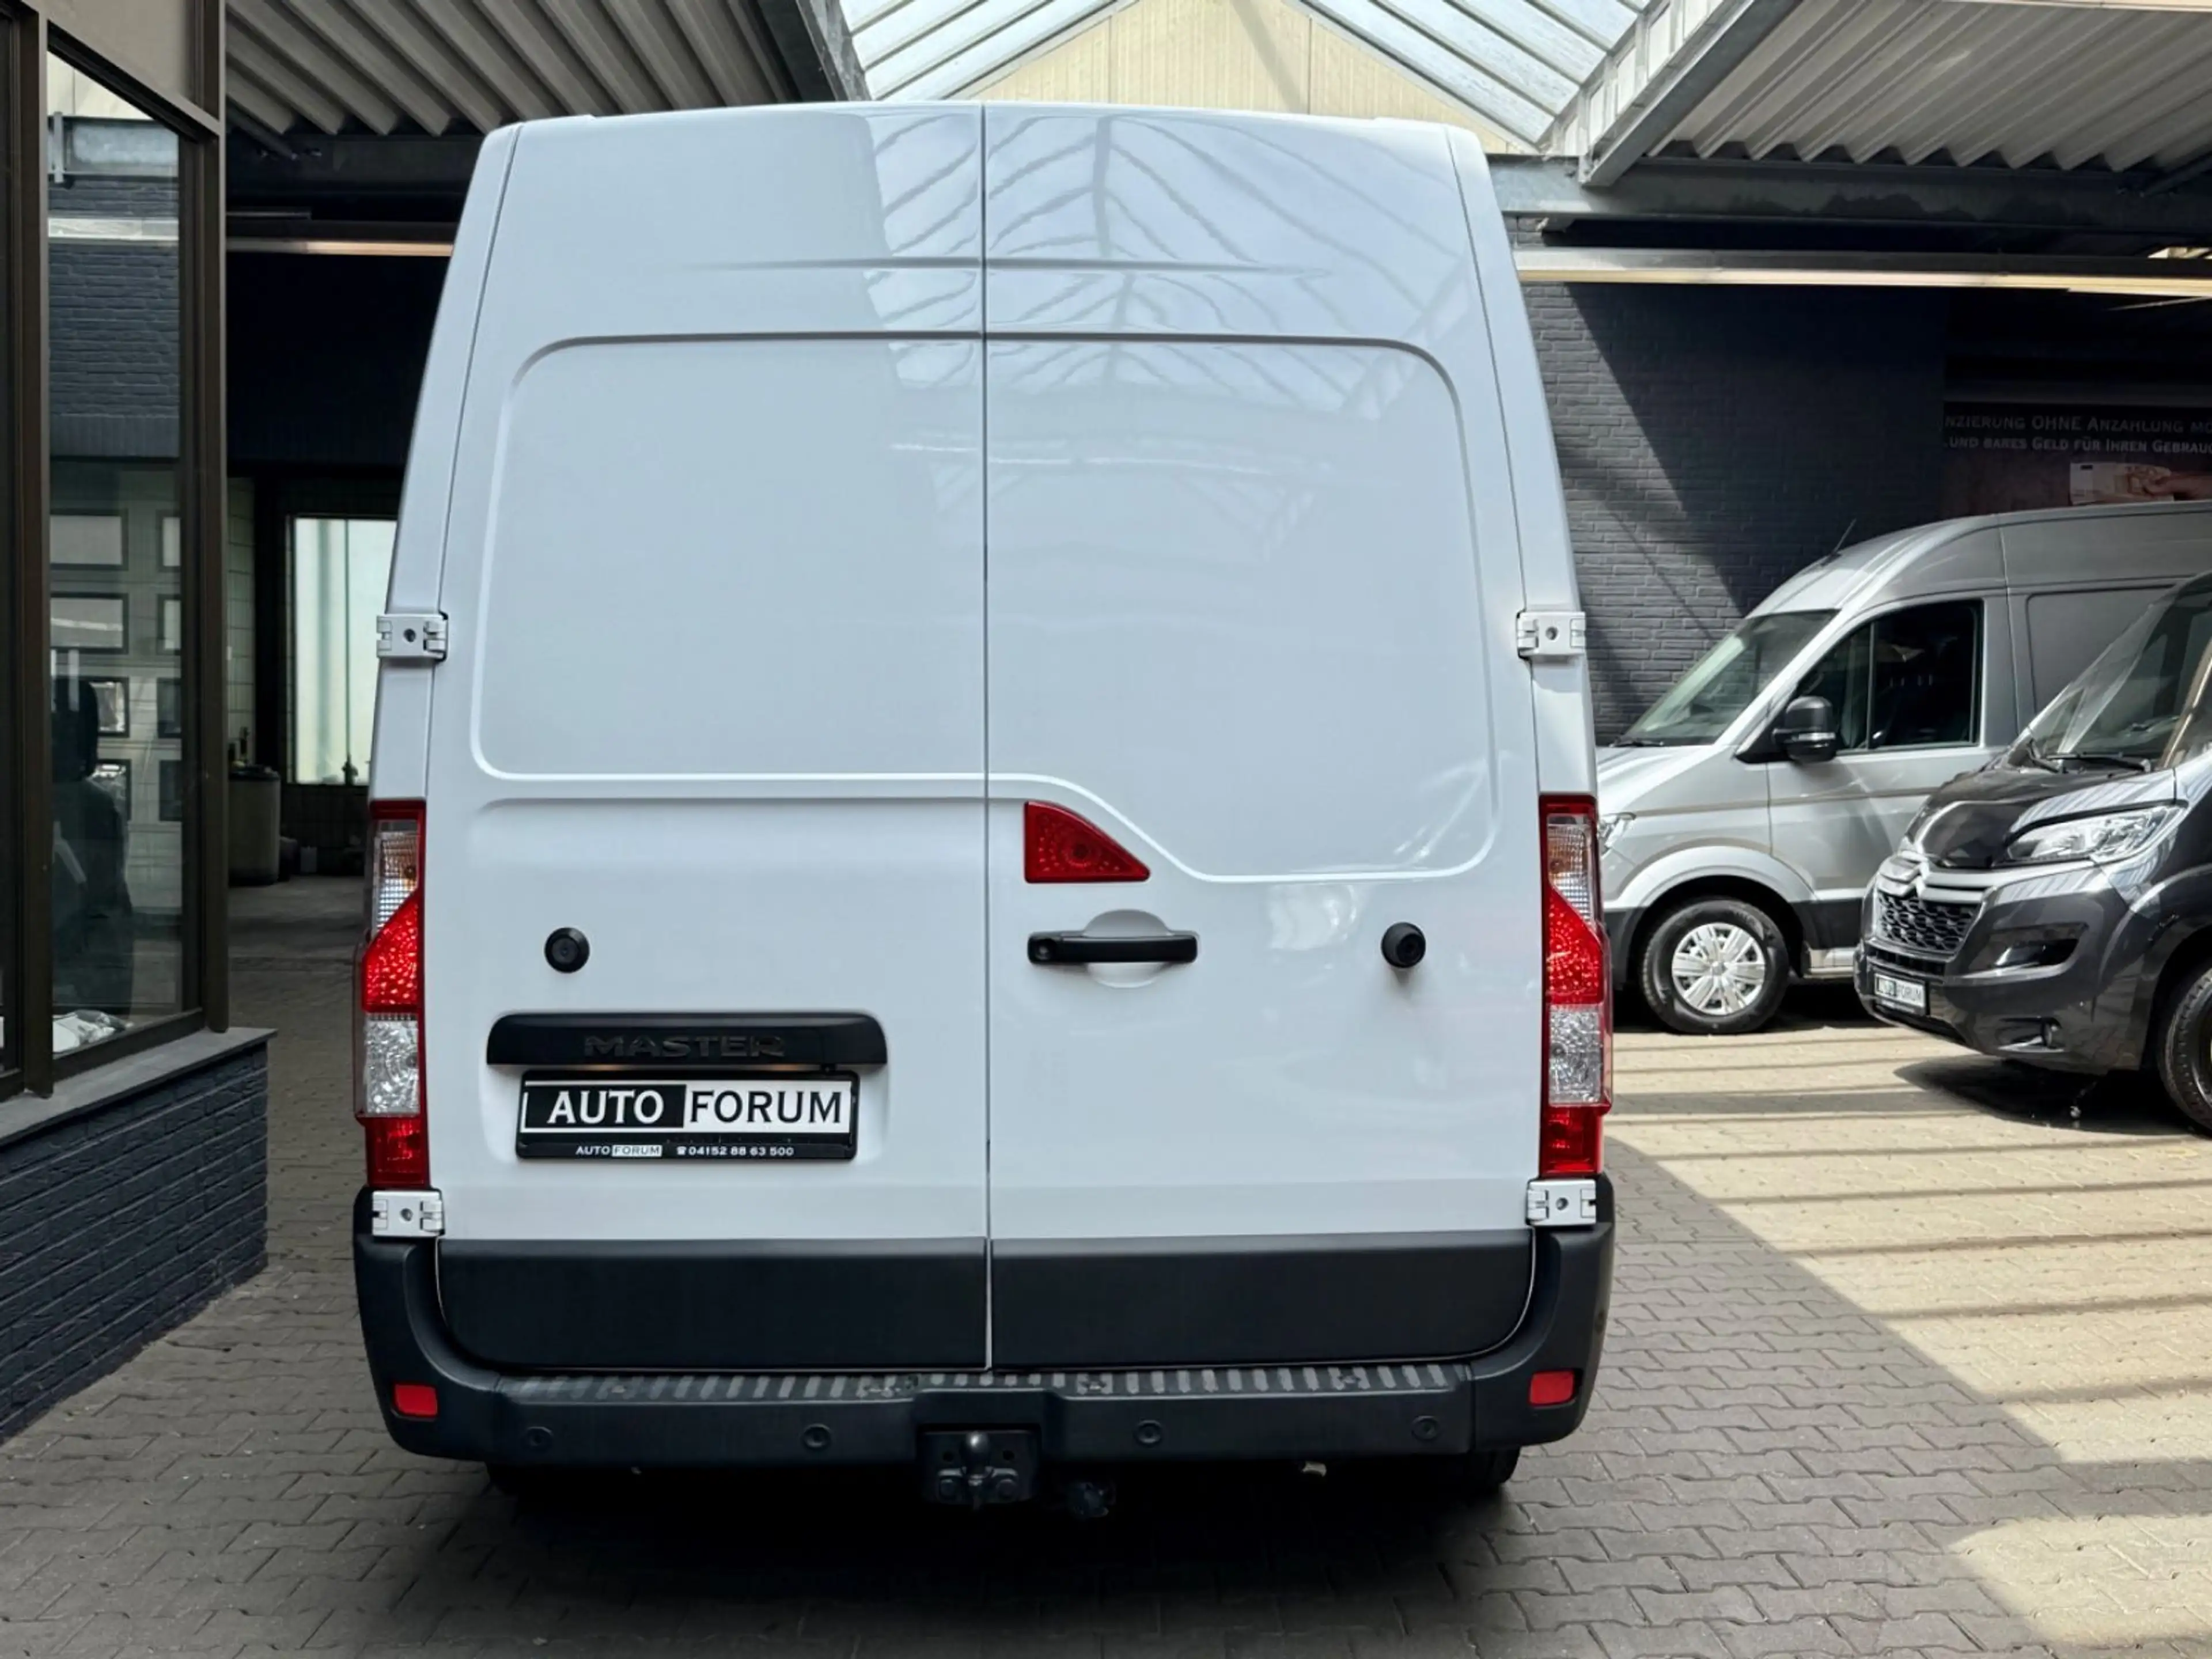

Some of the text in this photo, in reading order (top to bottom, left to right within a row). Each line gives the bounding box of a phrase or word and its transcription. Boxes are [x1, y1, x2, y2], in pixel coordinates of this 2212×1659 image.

[2032, 415, 2081, 431] OHNE
[2087, 416, 2184, 433] ANZAHLUNG
[1983, 438, 2028, 450] BARES
[2032, 436, 2069, 451] GELD
[2074, 435, 2101, 452] FÜR
[2106, 438, 2147, 453] IHREN
[584, 1035, 786, 1058] MASTER
[547, 1090, 842, 1124] AUTO FORUM
[576, 1145, 794, 1156] AUTO FORUM 04152 88 63 500
